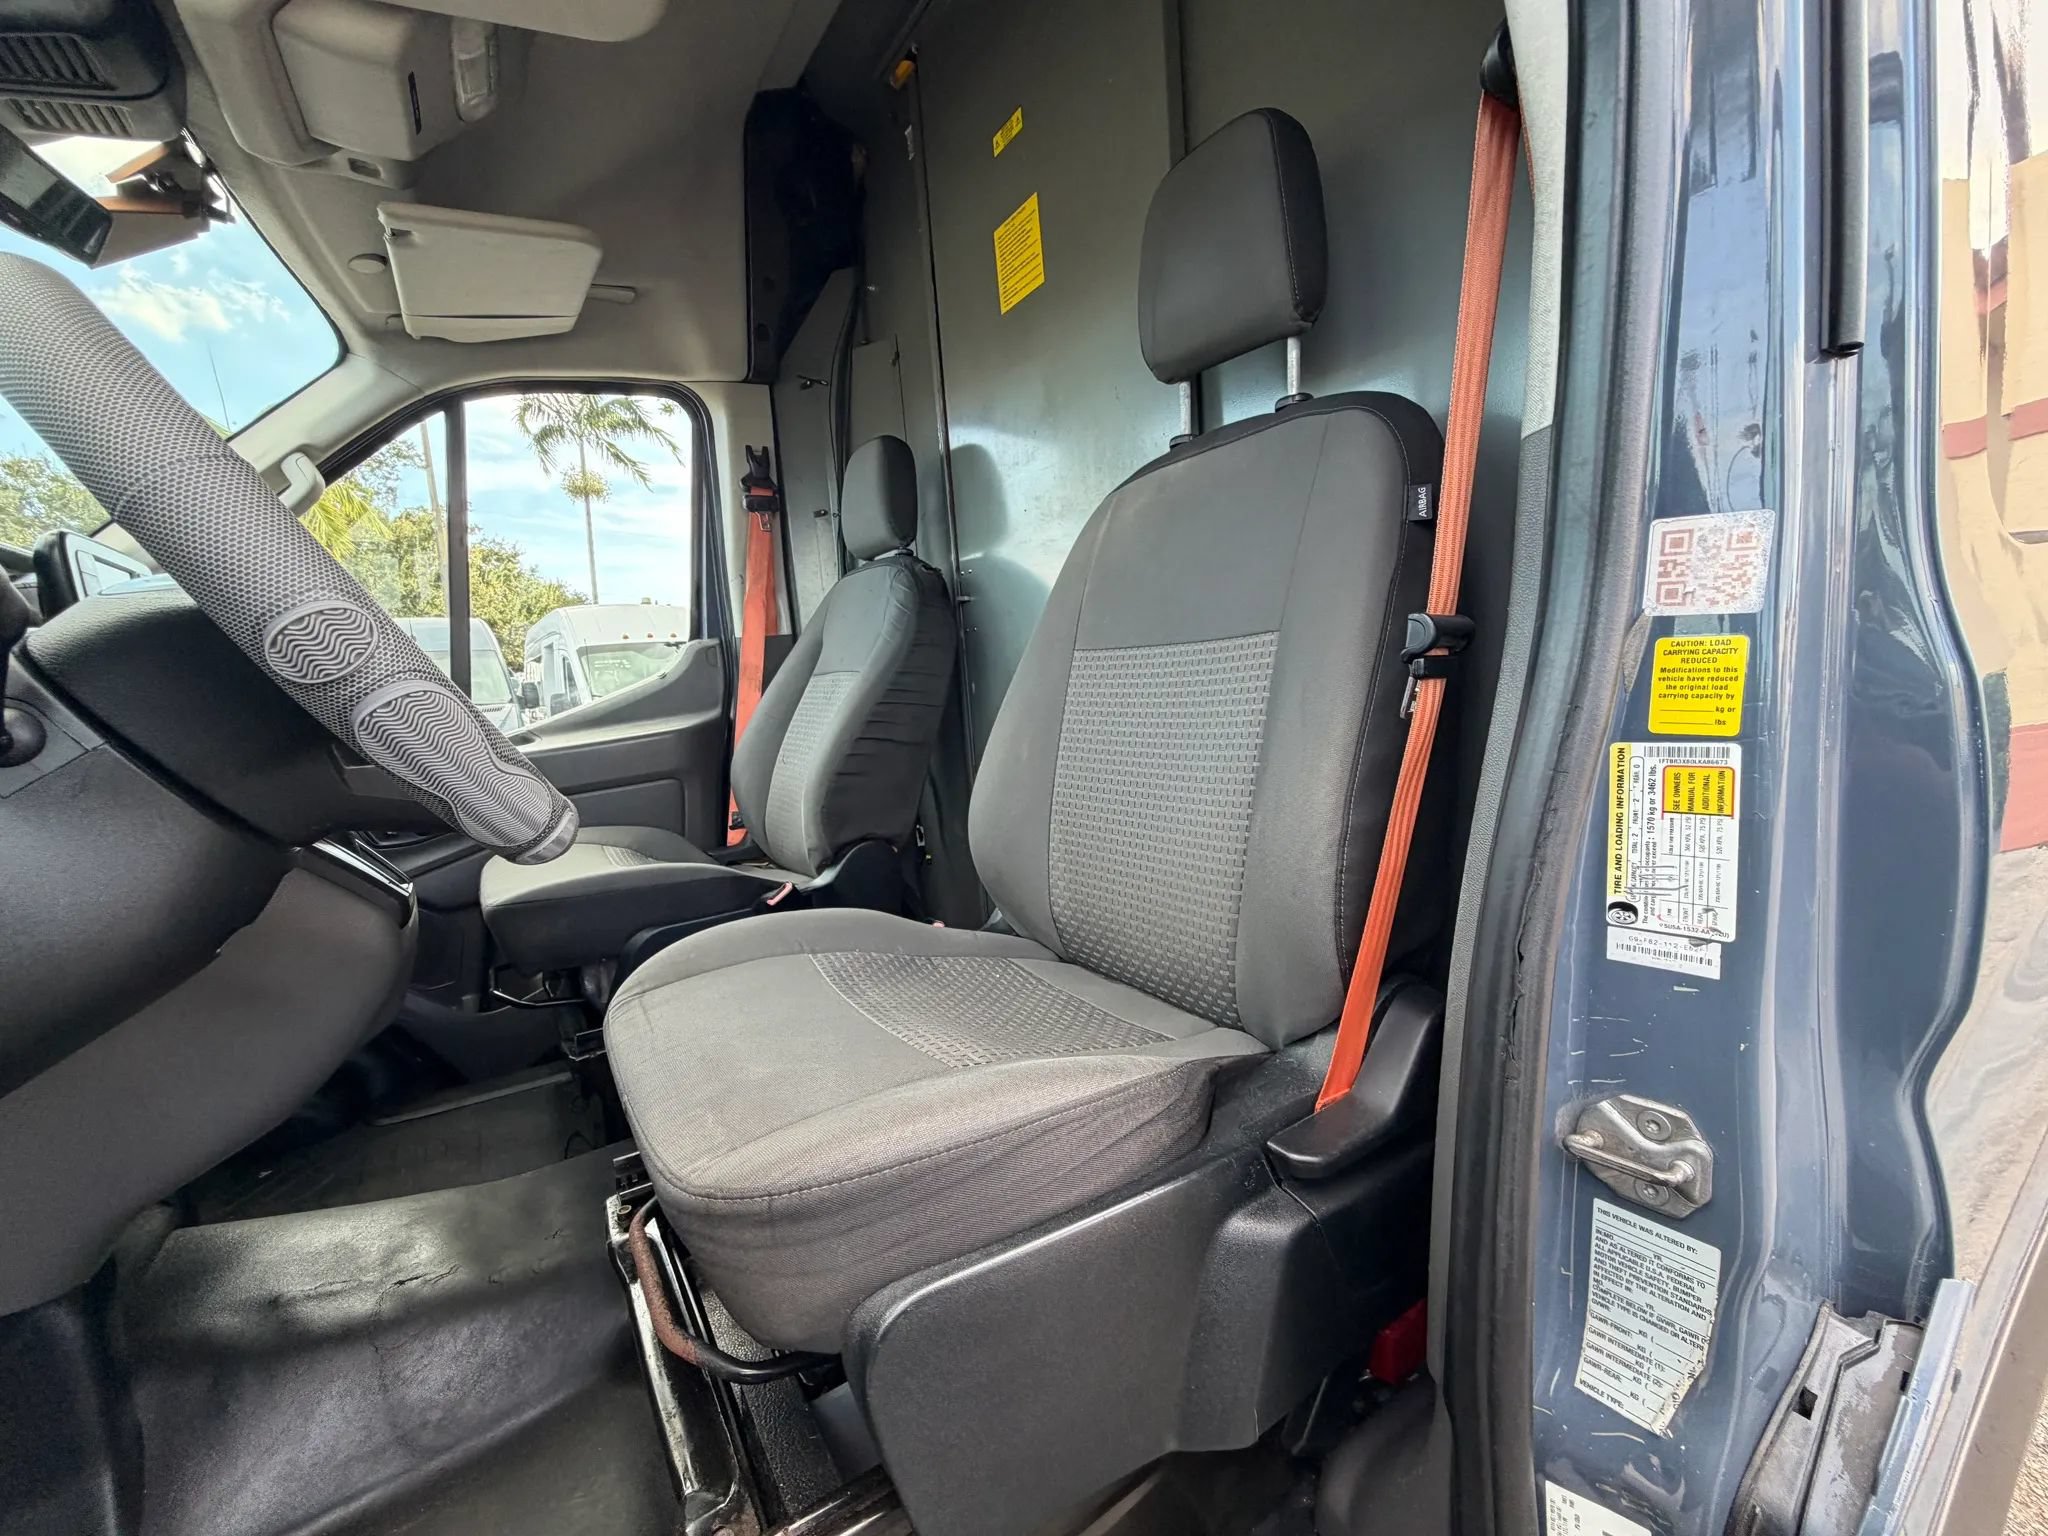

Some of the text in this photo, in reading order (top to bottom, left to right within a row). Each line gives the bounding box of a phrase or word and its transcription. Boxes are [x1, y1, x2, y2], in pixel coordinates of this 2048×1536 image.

[1418, 487, 1427, 517] AIRBAG
[1616, 748, 1625, 809] INFORMATION
[1648, 764, 1656, 777] lbs.
[1648, 777, 1656, 795] 3462
[1702, 774, 1710, 810] ADDITIONAL
[1717, 770, 1725, 813] INFORMATION
[1615, 812, 1624, 850] LOADING
[1647, 817, 1655, 834] 1570
[1597, 1207, 1698, 1254] THIS VEHICLE WAS ALTERED BY:
[1594, 1257, 1606, 1266] AND
[1608, 1262, 1627, 1276] THEFT
[1628, 1273, 1669, 1295] PREVENTION
[1594, 1250, 1616, 1261] MOTOR
[1618, 1260, 1642, 1276] VEHICLE
[1673, 1286, 1702, 1303] BUMPER
[1595, 1243, 1606, 1251] ALL
[1607, 1248, 1645, 1269] APPLICABLE
[1666, 1275, 1697, 1293] FEDERAL
[1596, 1236, 1705, 1289] AND AS ALTERED IT CONFORMS TO
[1601, 1273, 1623, 1288] EFFECT
[1594, 1264, 1706, 1320] AFFECTED BY THE ALTERATION AND
[1592, 1284, 1624, 1304] COMPLETE
[1626, 1298, 1648, 1315] BELOW
[1679, 1328, 1700, 1341] GAWR
[1592, 1290, 1615, 1307] VEHICLE
[1616, 1303, 1631, 1314] TYPE
[1640, 1315, 1669, 1333] CHANGED
[1670, 1331, 1680, 1339] OR
[1586, 1342, 1604, 1355] GAWR
[1605, 1352, 1651, 1382] INTERMEDIATE
[1588, 1326, 1606, 1340] GAWR
[1607, 1336, 1654, 1366] INTERMEDIATE
[1635, 1360, 1645, 1369] KG
[1580, 1378, 1624, 1409] VEHICLE TYPE:
[1630, 1391, 1639, 1400] KG
[1633, 1375, 1642, 1385] KG
